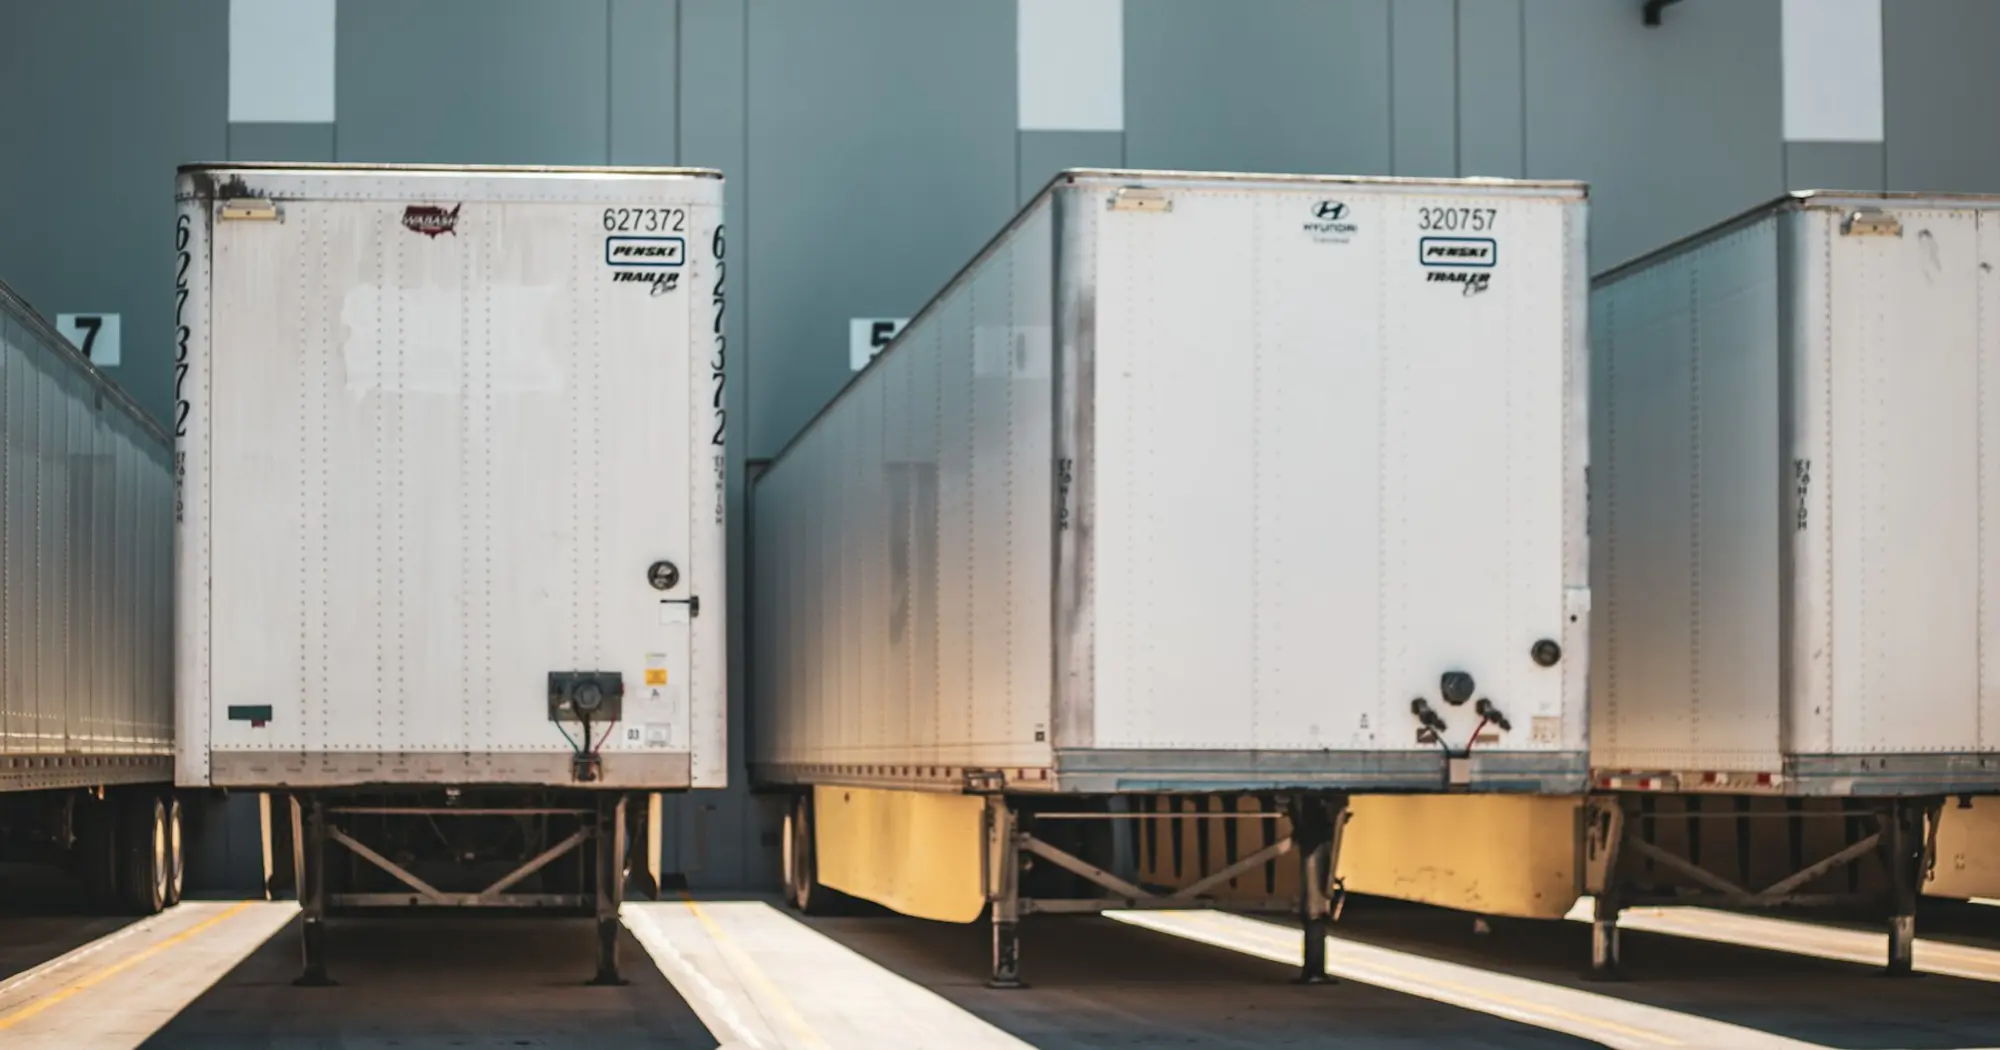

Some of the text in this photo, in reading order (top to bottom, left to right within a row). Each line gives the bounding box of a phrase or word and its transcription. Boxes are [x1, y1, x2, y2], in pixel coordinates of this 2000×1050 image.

[603, 208, 685, 231] 627372
[1418, 207, 1498, 231] 320757
[612, 246, 679, 256] PENSKE
[612, 271, 680, 283] TRAILER
[175, 215, 191, 437] 627372
[711, 224, 727, 446] 627372
[74, 317, 103, 360] 7
